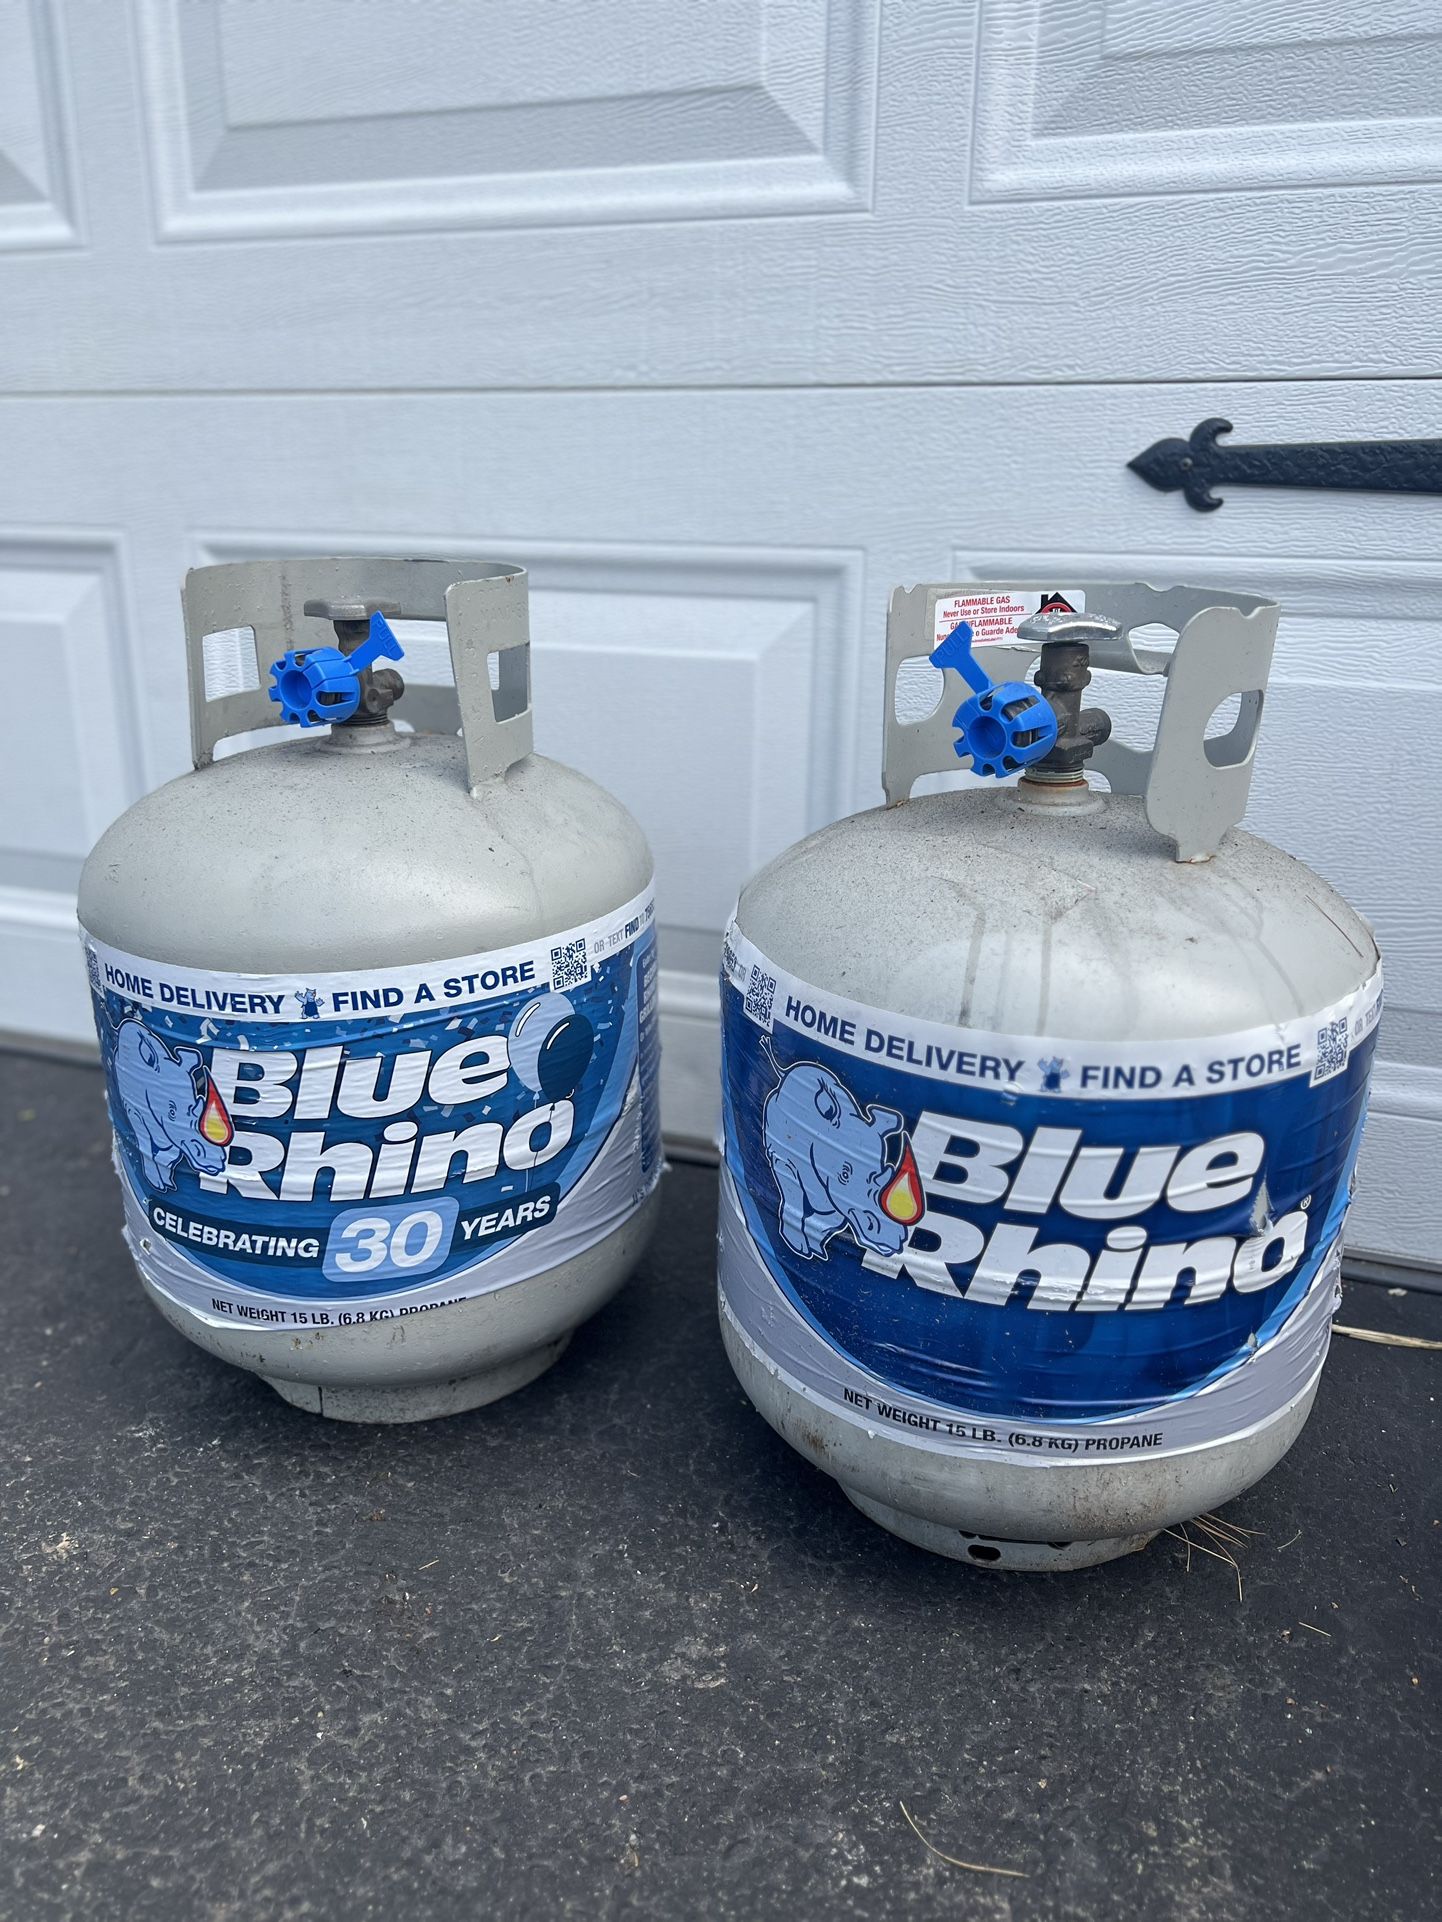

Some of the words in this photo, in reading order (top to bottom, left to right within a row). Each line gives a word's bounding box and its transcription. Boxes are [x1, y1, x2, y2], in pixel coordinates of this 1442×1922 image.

[943, 610, 959, 619] Never
[961, 608, 972, 617] Use
[972, 608, 980, 616] or
[980, 606, 998, 614] Store
[999, 604, 1025, 613] Indoors
[954, 596, 995, 608] FLAMMABLE
[996, 595, 1011, 604] GAS
[981, 628, 1005, 637] Guarde
[104, 962, 154, 999] HOME
[159, 982, 286, 1014] DELIVERY
[332, 987, 404, 1012] FIND
[414, 983, 436, 1004] A
[443, 960, 536, 998] STORE
[593, 940, 605, 954] OR
[608, 929, 624, 947] TEXT
[624, 917, 640, 939] FIND
[204, 1034, 512, 1121] Blue
[785, 995, 857, 1046] HOME
[864, 1028, 1026, 1082] DELIVERY
[1080, 1065, 1162, 1090] FIND
[1172, 1064, 1196, 1088] A
[1206, 1043, 1302, 1085] STORE
[200, 1100, 575, 1202] Rhino
[904, 1111, 1266, 1219] Blue
[152, 1207, 320, 1258] CELEBRATING
[334, 1210, 443, 1273] 30
[461, 1195, 551, 1241] YEARS
[861, 1209, 1309, 1313] Rhino
[211, 1298, 234, 1315] NET
[236, 1304, 286, 1323] WEIGHT
[291, 1313, 308, 1324] 15
[312, 1313, 334, 1325] LB.
[338, 1312, 366, 1326] (6.8
[369, 1309, 394, 1321] KG)
[844, 1387, 872, 1411] NET
[877, 1402, 942, 1432] WEIGHT
[946, 1423, 967, 1438] 15
[971, 1429, 1001, 1443] LB.
[1008, 1432, 1043, 1449] (6.8
[1048, 1437, 1079, 1453] KG)
[1084, 1432, 1164, 1451] PROPANE
